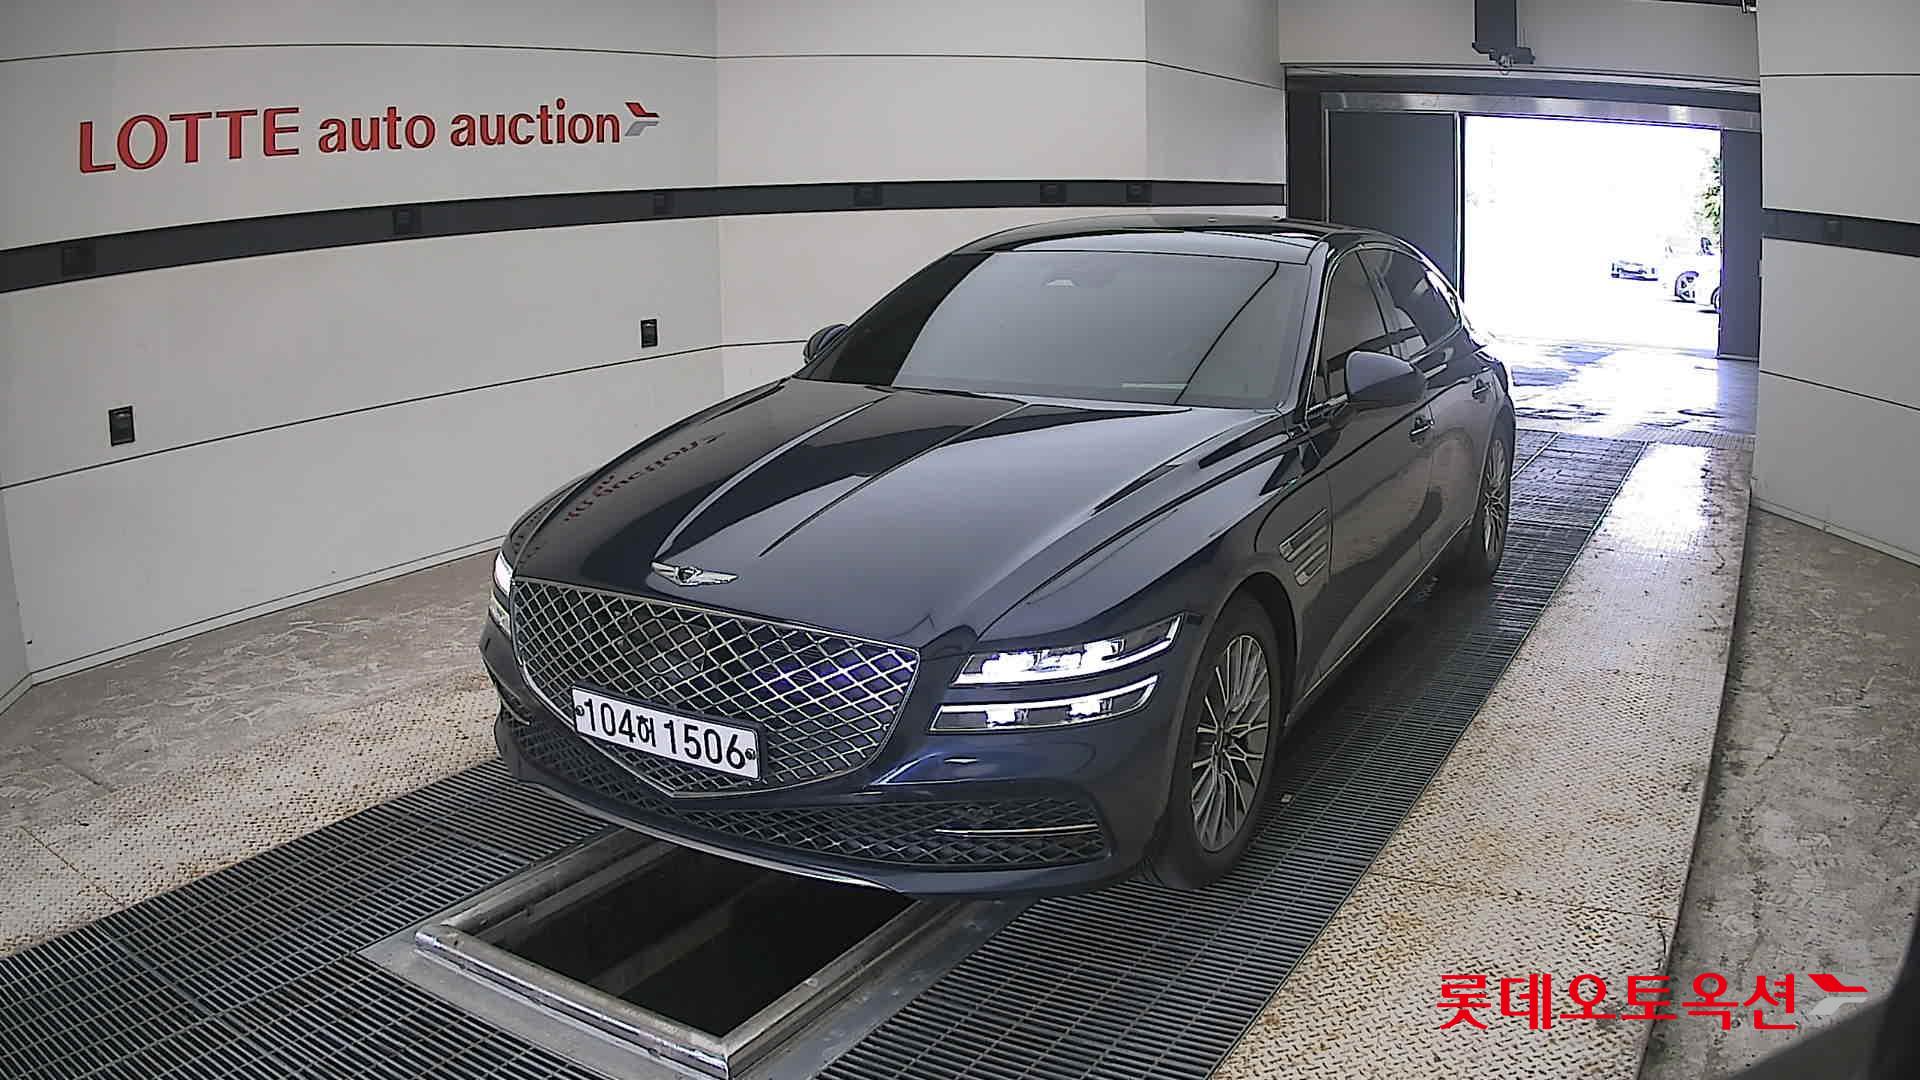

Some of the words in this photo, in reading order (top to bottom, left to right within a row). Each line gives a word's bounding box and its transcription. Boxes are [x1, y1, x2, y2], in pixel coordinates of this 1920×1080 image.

[79, 106, 300, 173] LOTTE
[317, 106, 436, 153] auto
[449, 98, 621, 147] auction
[663, 719, 747, 770] 1506
